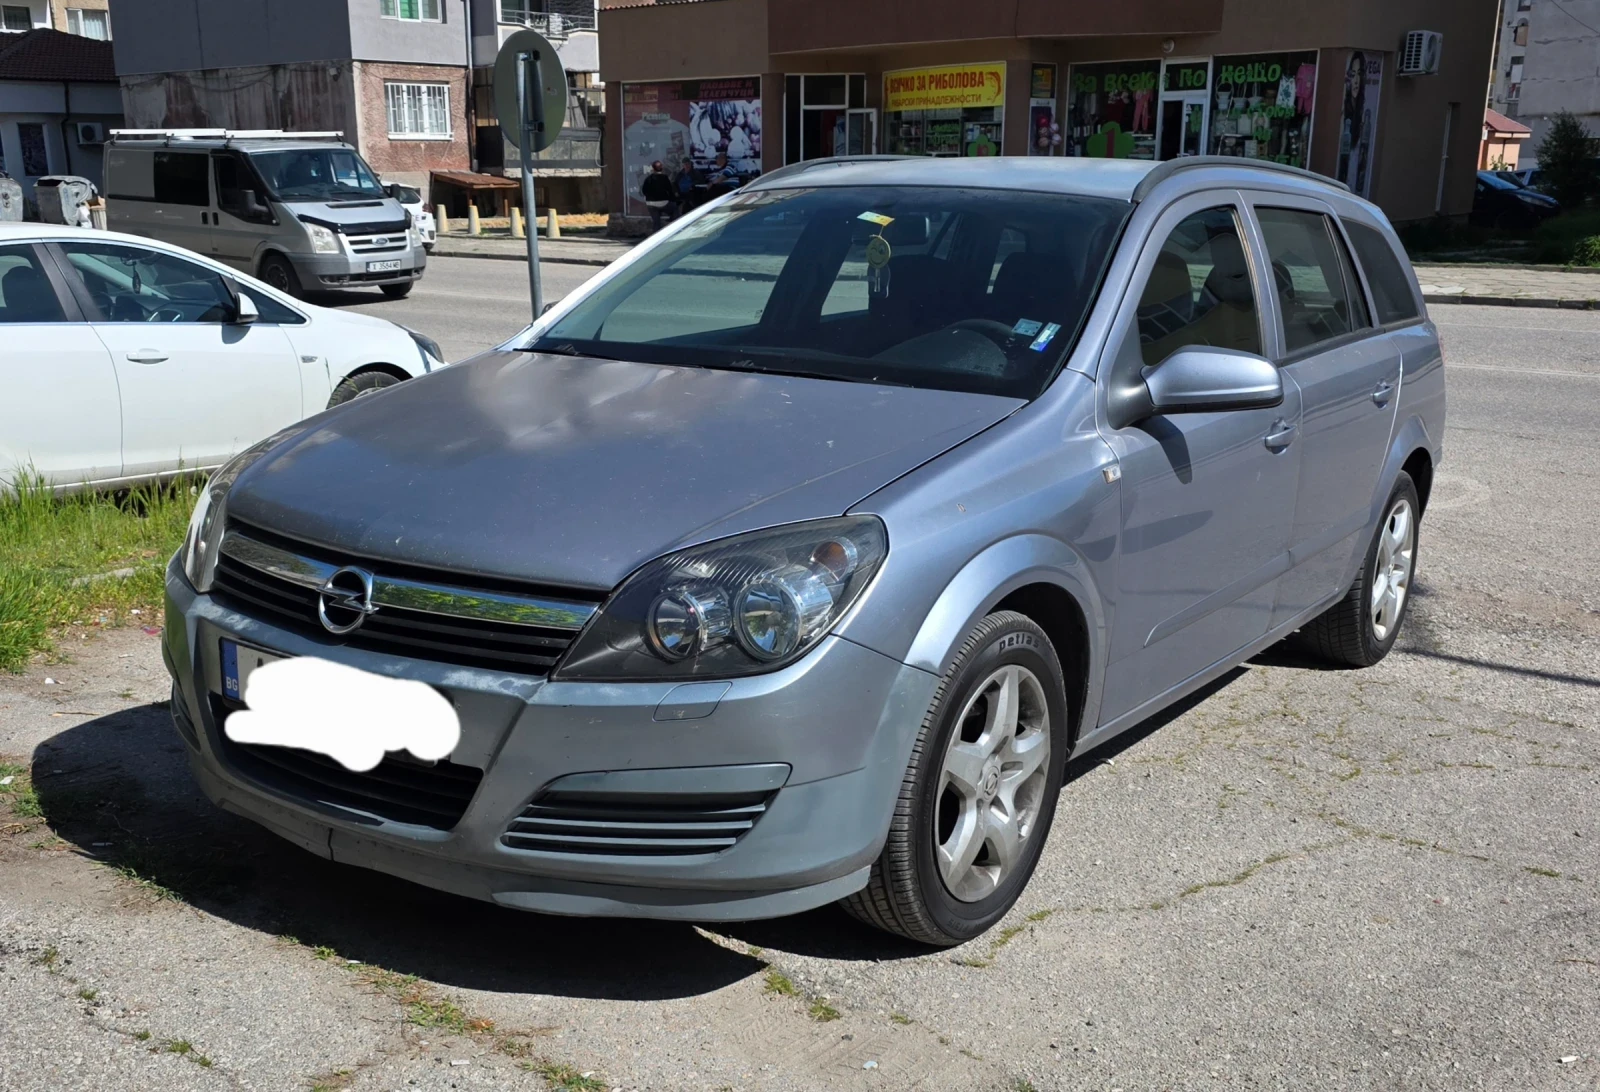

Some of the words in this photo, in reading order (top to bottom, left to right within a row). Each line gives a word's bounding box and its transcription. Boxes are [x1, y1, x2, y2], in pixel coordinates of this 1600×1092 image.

[889, 74, 915, 94] ВСИЧКО
[916, 74, 926, 92] ЗА
[928, 71, 985, 91] РИБОЛОВА
[918, 93, 982, 106] ПРИНАДЛЕЖНОСТИ
[999, 633, 1040, 654] petlas
[226, 677, 238, 691] BG
